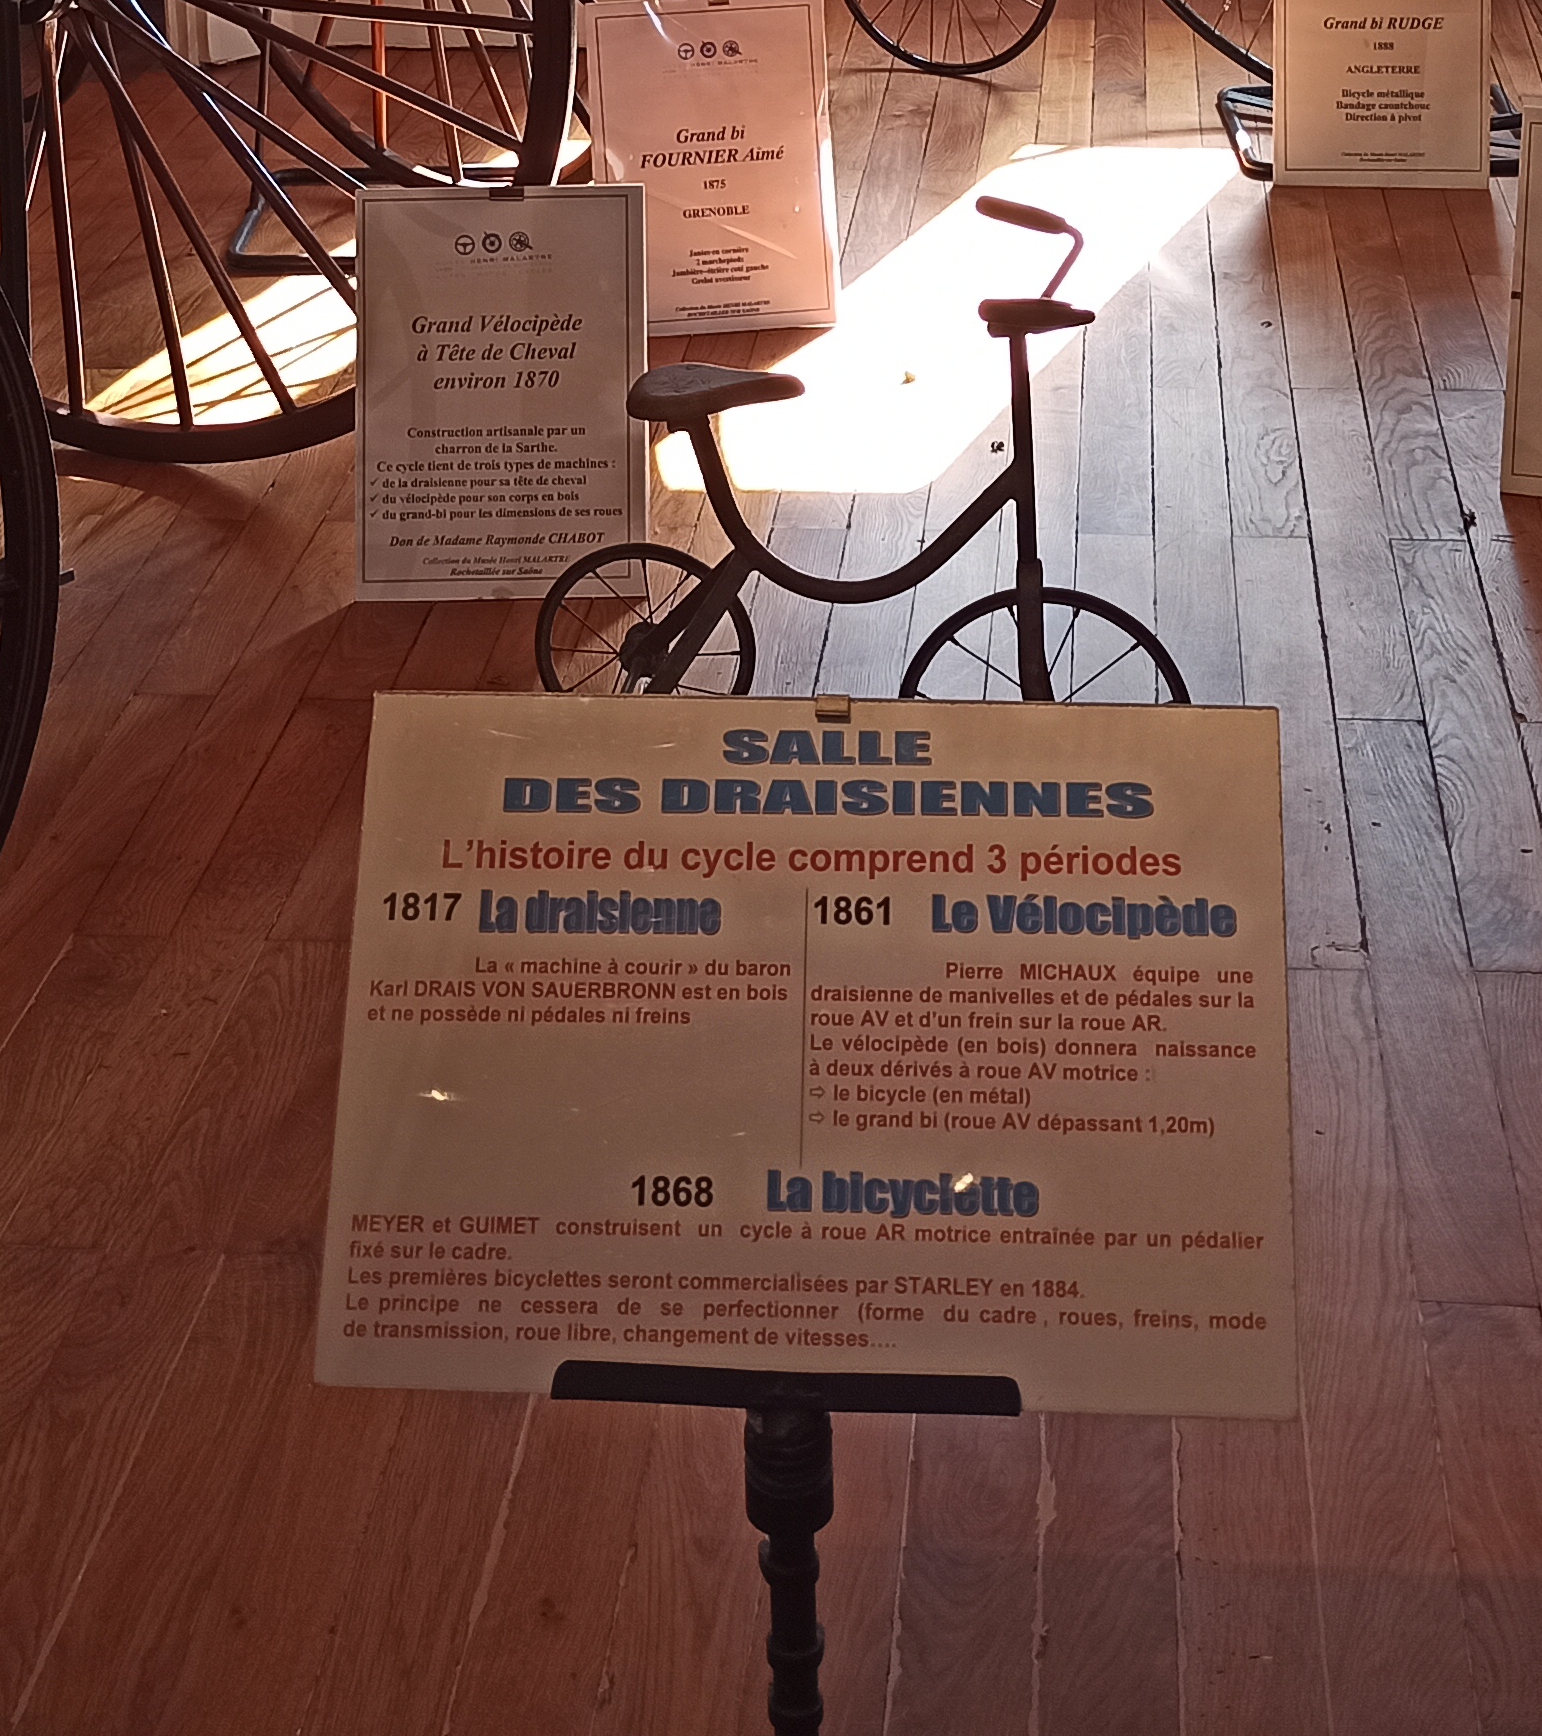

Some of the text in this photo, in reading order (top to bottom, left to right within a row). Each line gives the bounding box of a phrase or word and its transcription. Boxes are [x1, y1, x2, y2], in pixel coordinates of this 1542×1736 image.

[1323, 16, 1444, 29] Grand bi RUDGE
[1373, 41, 1394, 50] 1888
[1346, 64, 1420, 74] ANGLETERRE
[1341, 88, 1424, 100] Bicycle métallique
[1335, 100, 1376, 111] Bandage
[1345, 111, 1387, 121] Direction
[1389, 113, 1395, 121] à
[676, 125, 745, 143] Grand bi
[640, 148, 738, 168] FOURNIER
[703, 178, 726, 189] 1875
[682, 204, 749, 218] GRENOBLE
[411, 313, 582, 336] Grand Vélocipède
[416, 341, 576, 361] à Tête de Cheval
[433, 369, 559, 389] environ 1870
[406, 425, 585, 438] Construction artisanale par un
[434, 441, 557, 454] charron de la Sarthe.
[381, 490, 579, 505] du vélocipède pour son corps en bois
[389, 531, 605, 547] Don de Madame Raymonde CHABOT
[722, 728, 932, 766] SALLE
[502, 777, 1154, 819] DES DRAISIENNES
[442, 839, 1181, 881] L'histoire du cycle comprend 3 périodes
[383, 892, 462, 921] 1817
[478, 888, 721, 935] La draisienne
[813, 895, 890, 925] 1861
[931, 893, 1237, 940] Le Vélocipède
[369, 979, 787, 1000] Karl DRAIS VON SAUERBRONN est en bois
[810, 984, 1254, 1010] draisienne de manivelles et de pédales sur la
[833, 1083, 1030, 1108] le bicycle (en métal)
[833, 1109, 1214, 1138] le grand bi (roue AV dépassant 1,20m)
[631, 1174, 713, 1207] 1868
[766, 1168, 812, 1212] La
[347, 1266, 1084, 1298] Les premières bicyclettes seront commercialisées par STARLEY en 1884.
